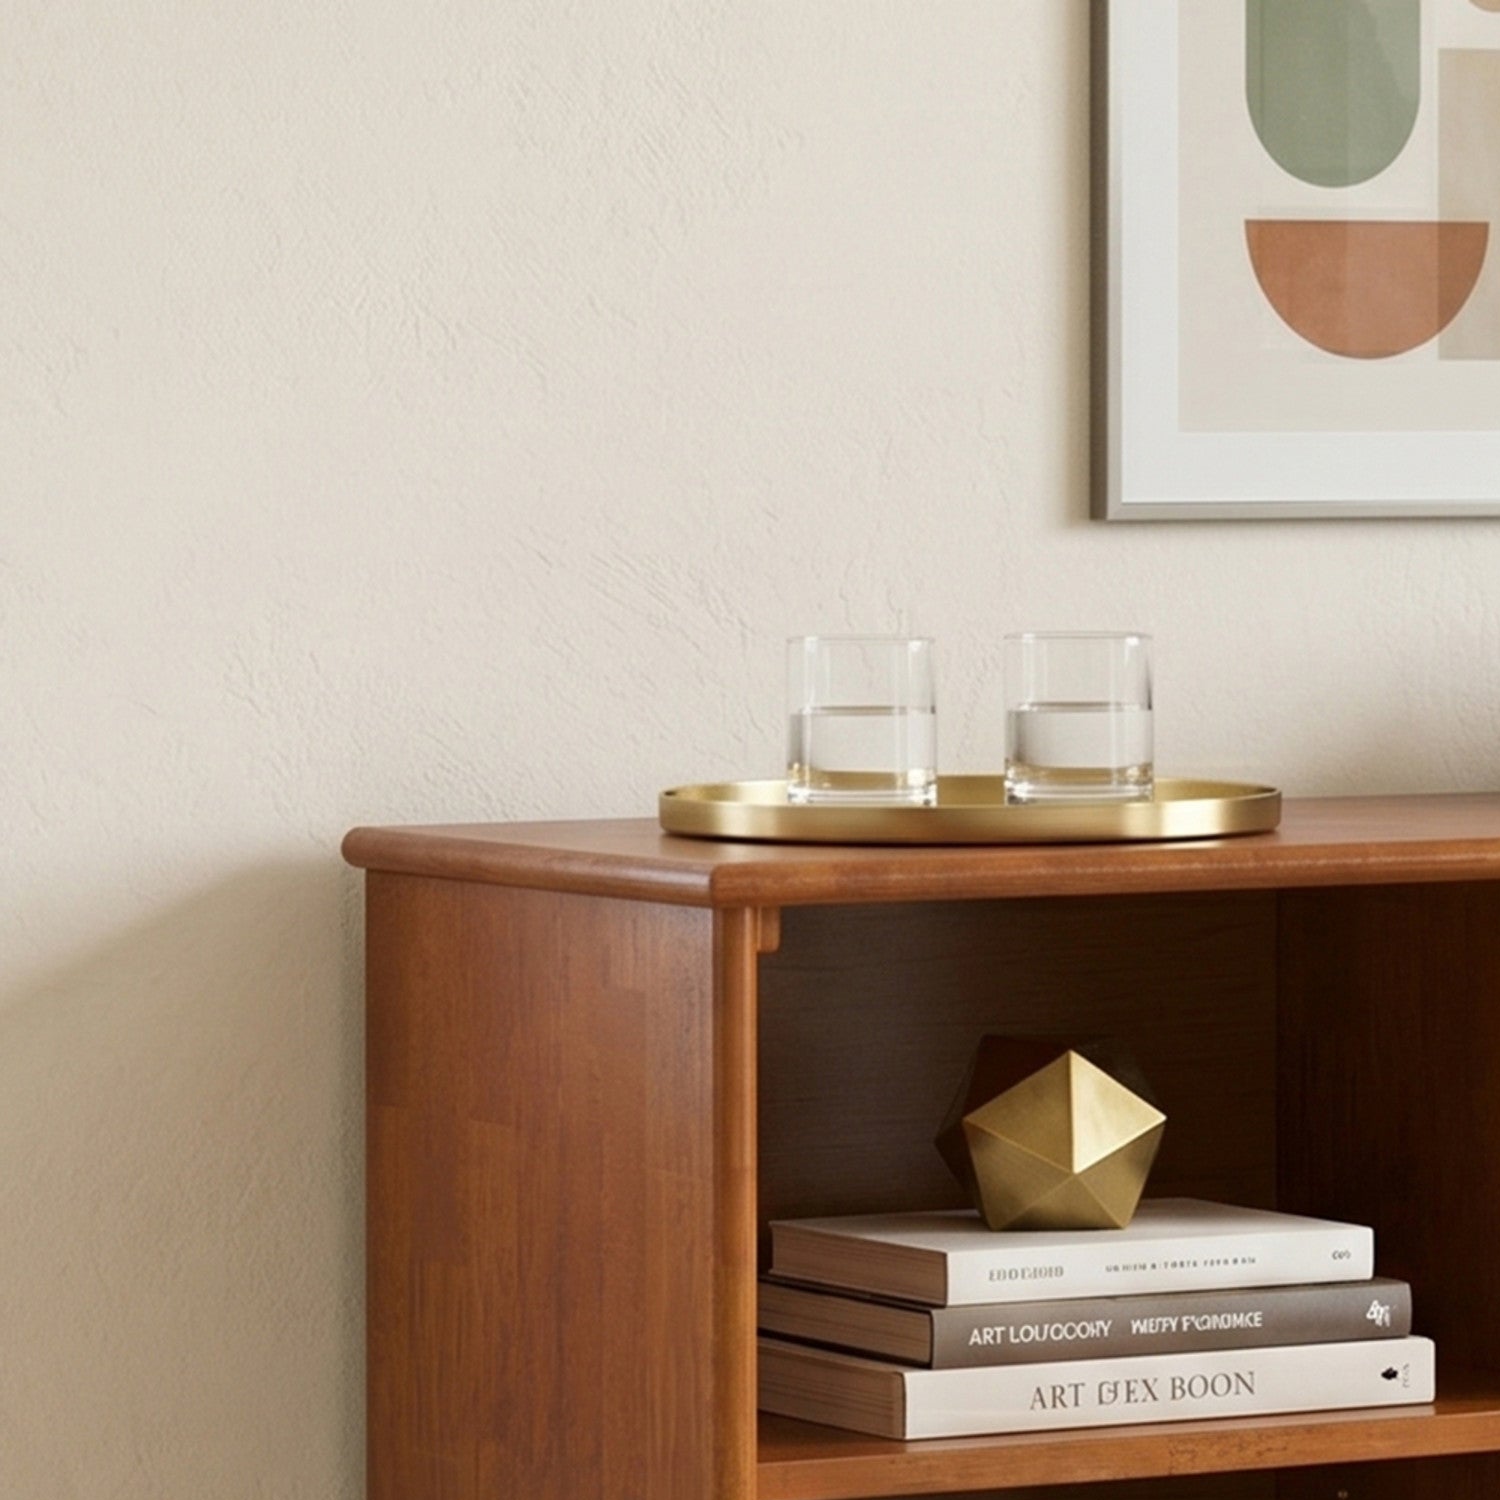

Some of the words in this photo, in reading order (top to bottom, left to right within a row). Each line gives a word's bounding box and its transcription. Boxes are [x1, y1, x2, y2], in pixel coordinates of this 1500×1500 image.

[968, 1326, 1005, 1346] ART
[1029, 1382, 1085, 1410] ART
[1169, 1370, 1255, 1401] BOON
